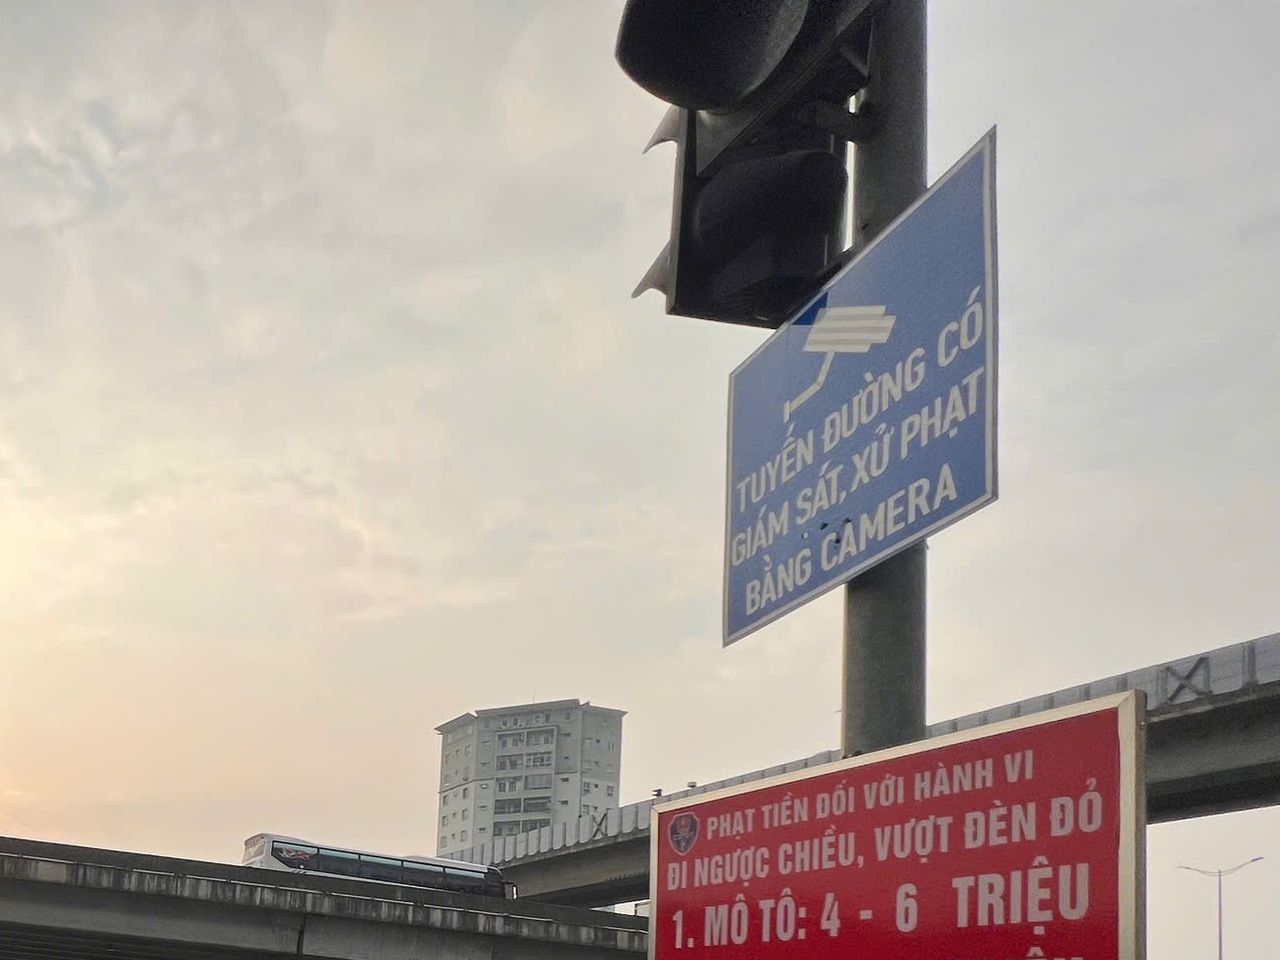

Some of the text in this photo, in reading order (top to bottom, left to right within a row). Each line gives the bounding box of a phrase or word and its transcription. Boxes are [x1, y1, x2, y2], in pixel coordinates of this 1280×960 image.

[737, 285, 984, 513] TUYẾN ĐƯỜNG CÓ
[731, 367, 984, 566] GIÁM SÁT, XỬ PHẠT
[746, 463, 957, 615] BẰNG CAMERA
[667, 777, 1103, 891] ĐI NGƯỢC CHIỀU, VƯỢT ĐÈN ĐỎ
[707, 749, 1033, 840] PHẠT TIỀN ĐỐI VỚI HÀNH VI
[672, 854, 1089, 949] 1. MÔ TÔ: 4 - 6 TRIỆU
